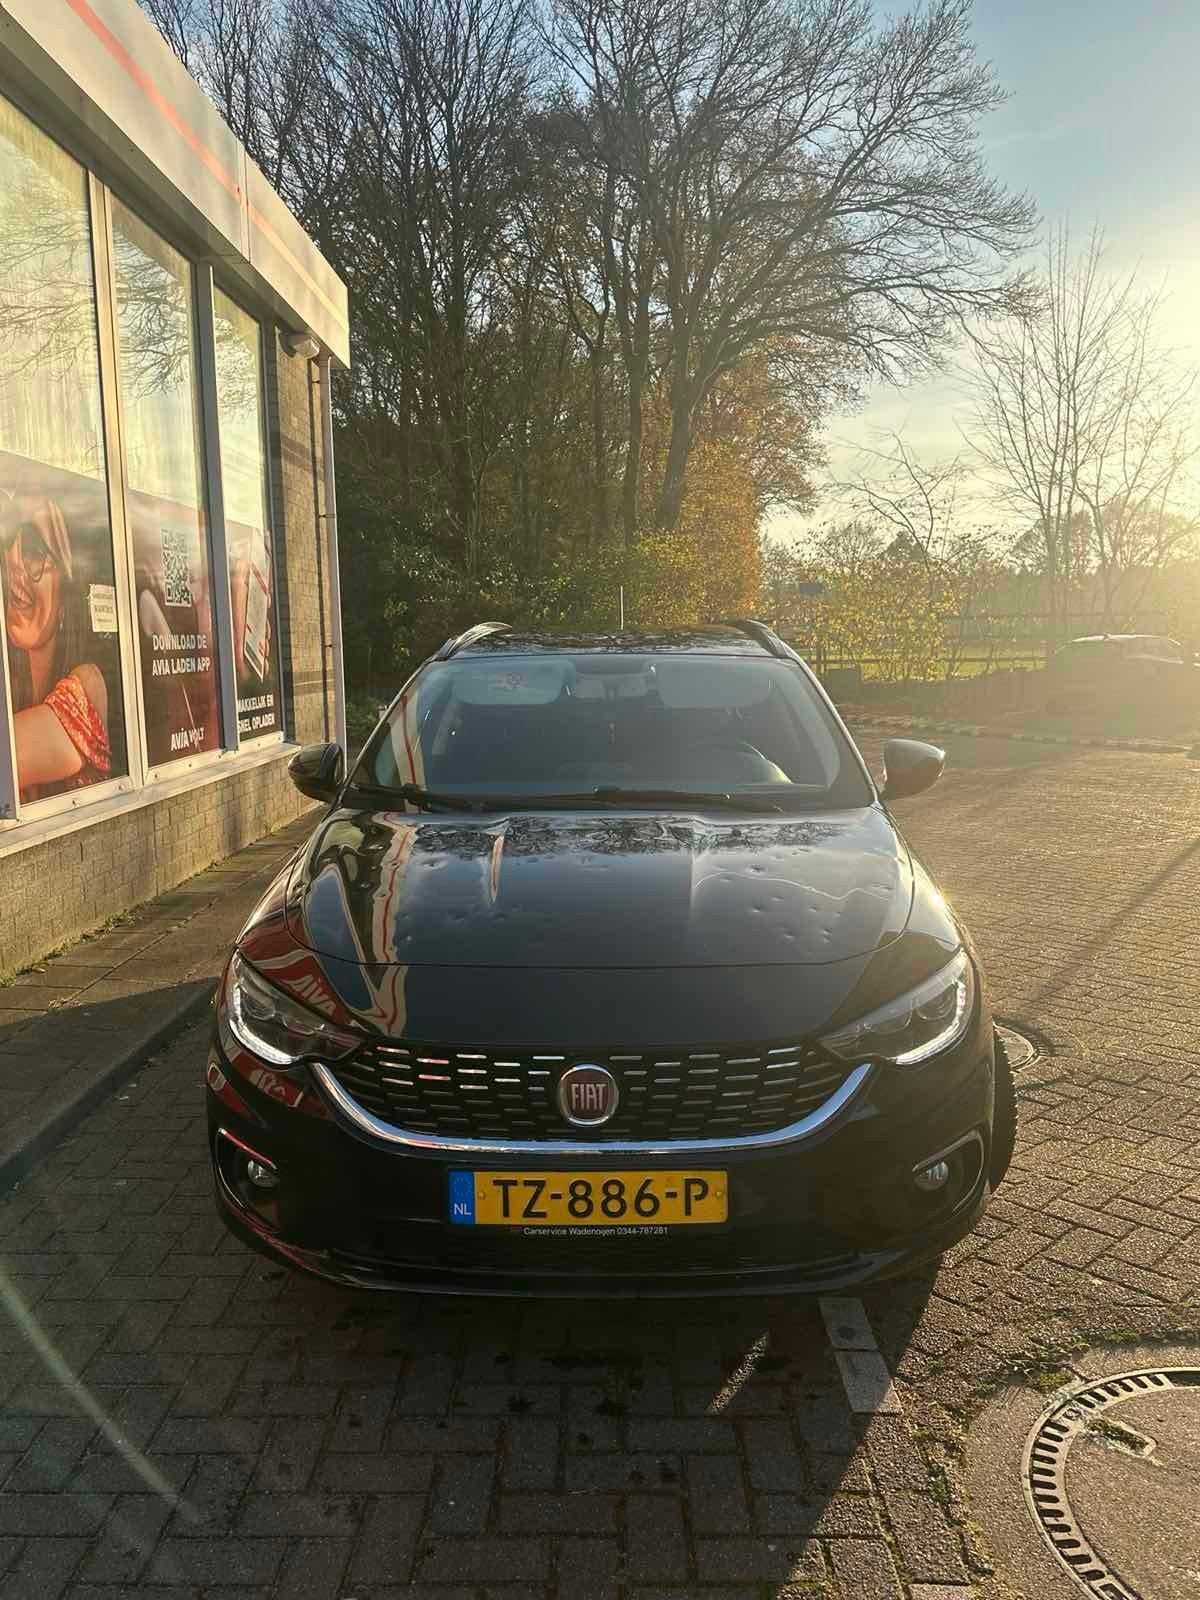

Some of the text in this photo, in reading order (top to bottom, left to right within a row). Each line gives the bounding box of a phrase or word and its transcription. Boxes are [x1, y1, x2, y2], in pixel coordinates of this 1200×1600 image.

[152, 634, 208, 651] DOWNLOAD DE
[152, 656, 211, 676] AVIA LADEN APP
[252, 712, 275, 730] OPLADEN
[170, 727, 190, 751] AVIA
[571, 1083, 607, 1110] FIAT
[493, 1178, 709, 1219] TZ-886-P
[453, 1203, 472, 1216] NL
[523, 1226, 568, 1236] Carservice
